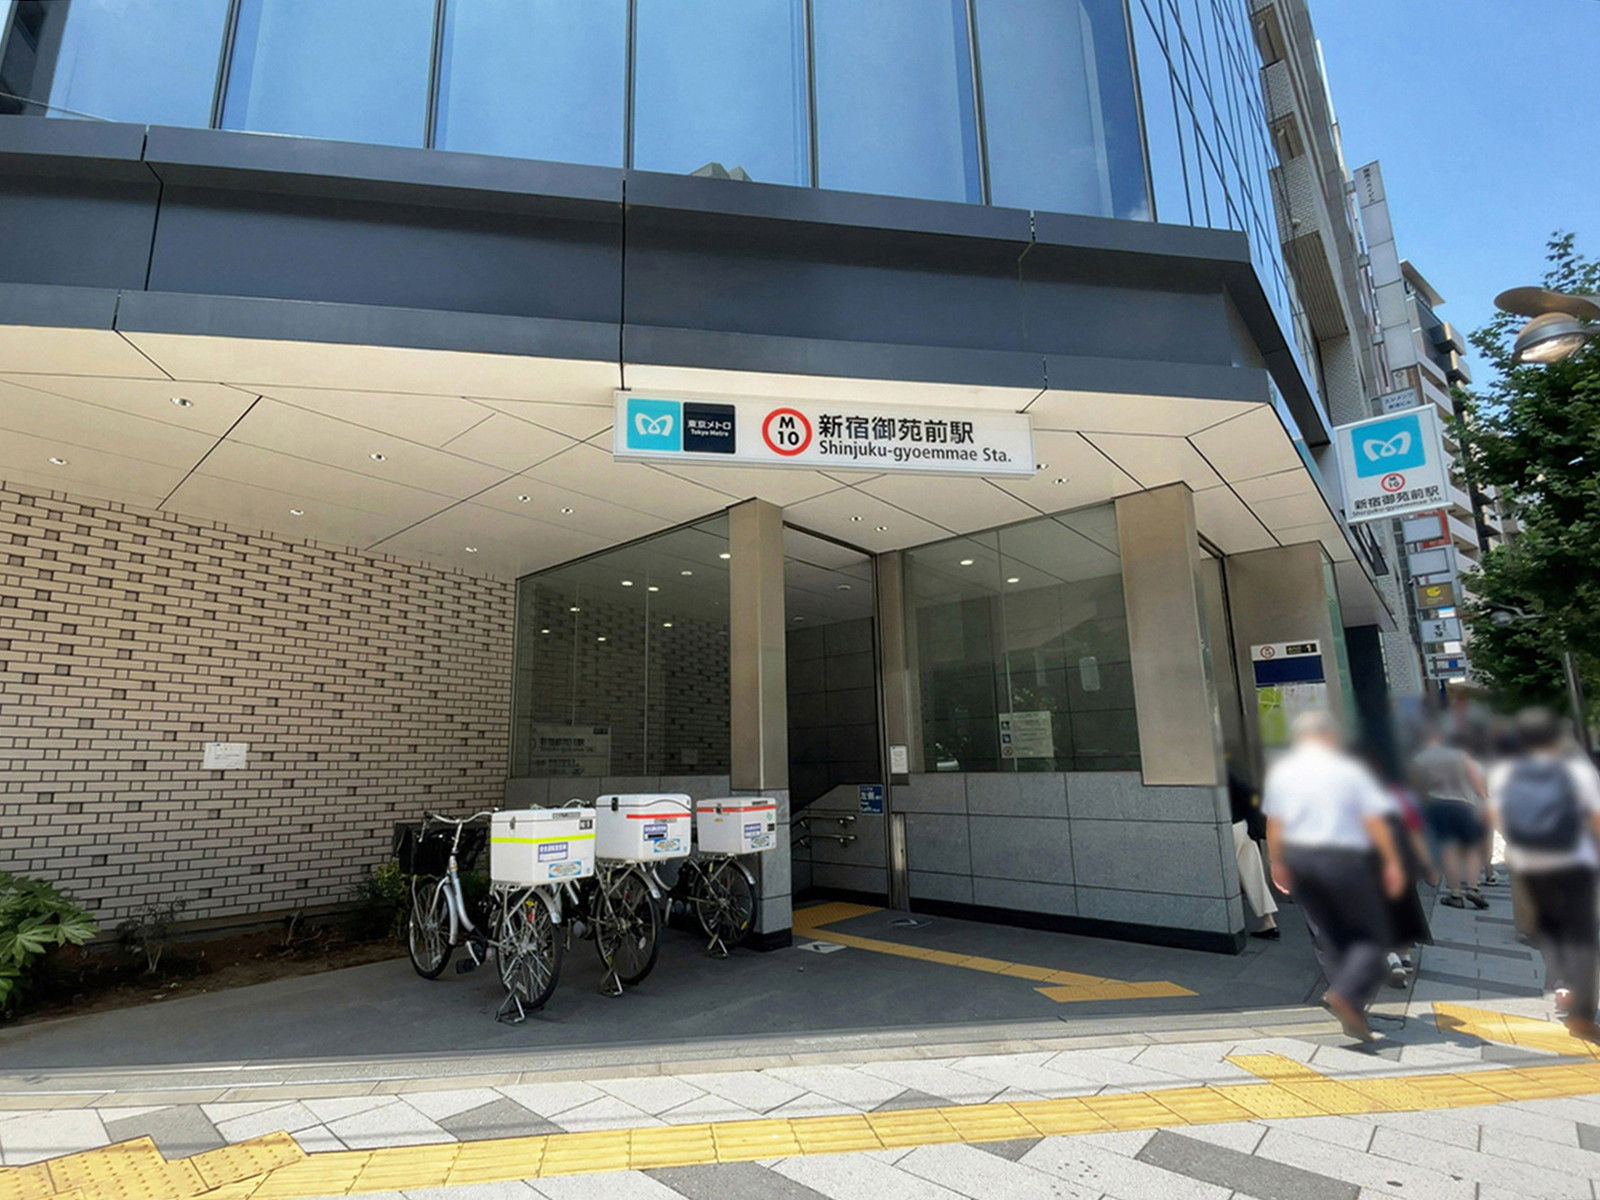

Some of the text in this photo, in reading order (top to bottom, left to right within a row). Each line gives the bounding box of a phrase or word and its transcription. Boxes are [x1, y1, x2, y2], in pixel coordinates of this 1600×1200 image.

[687, 420, 732, 430] 東京メトロ
[779, 416, 795, 429] M
[818, 413, 975, 445] 新宿御苑前駅
[690, 429, 709, 437] Tokyo
[777, 430, 800, 446] 10
[819, 439, 1012, 462] Shinjuku-gyoemmae Sta.
[1354, 485, 1439, 509] 新宿御苑前駅
